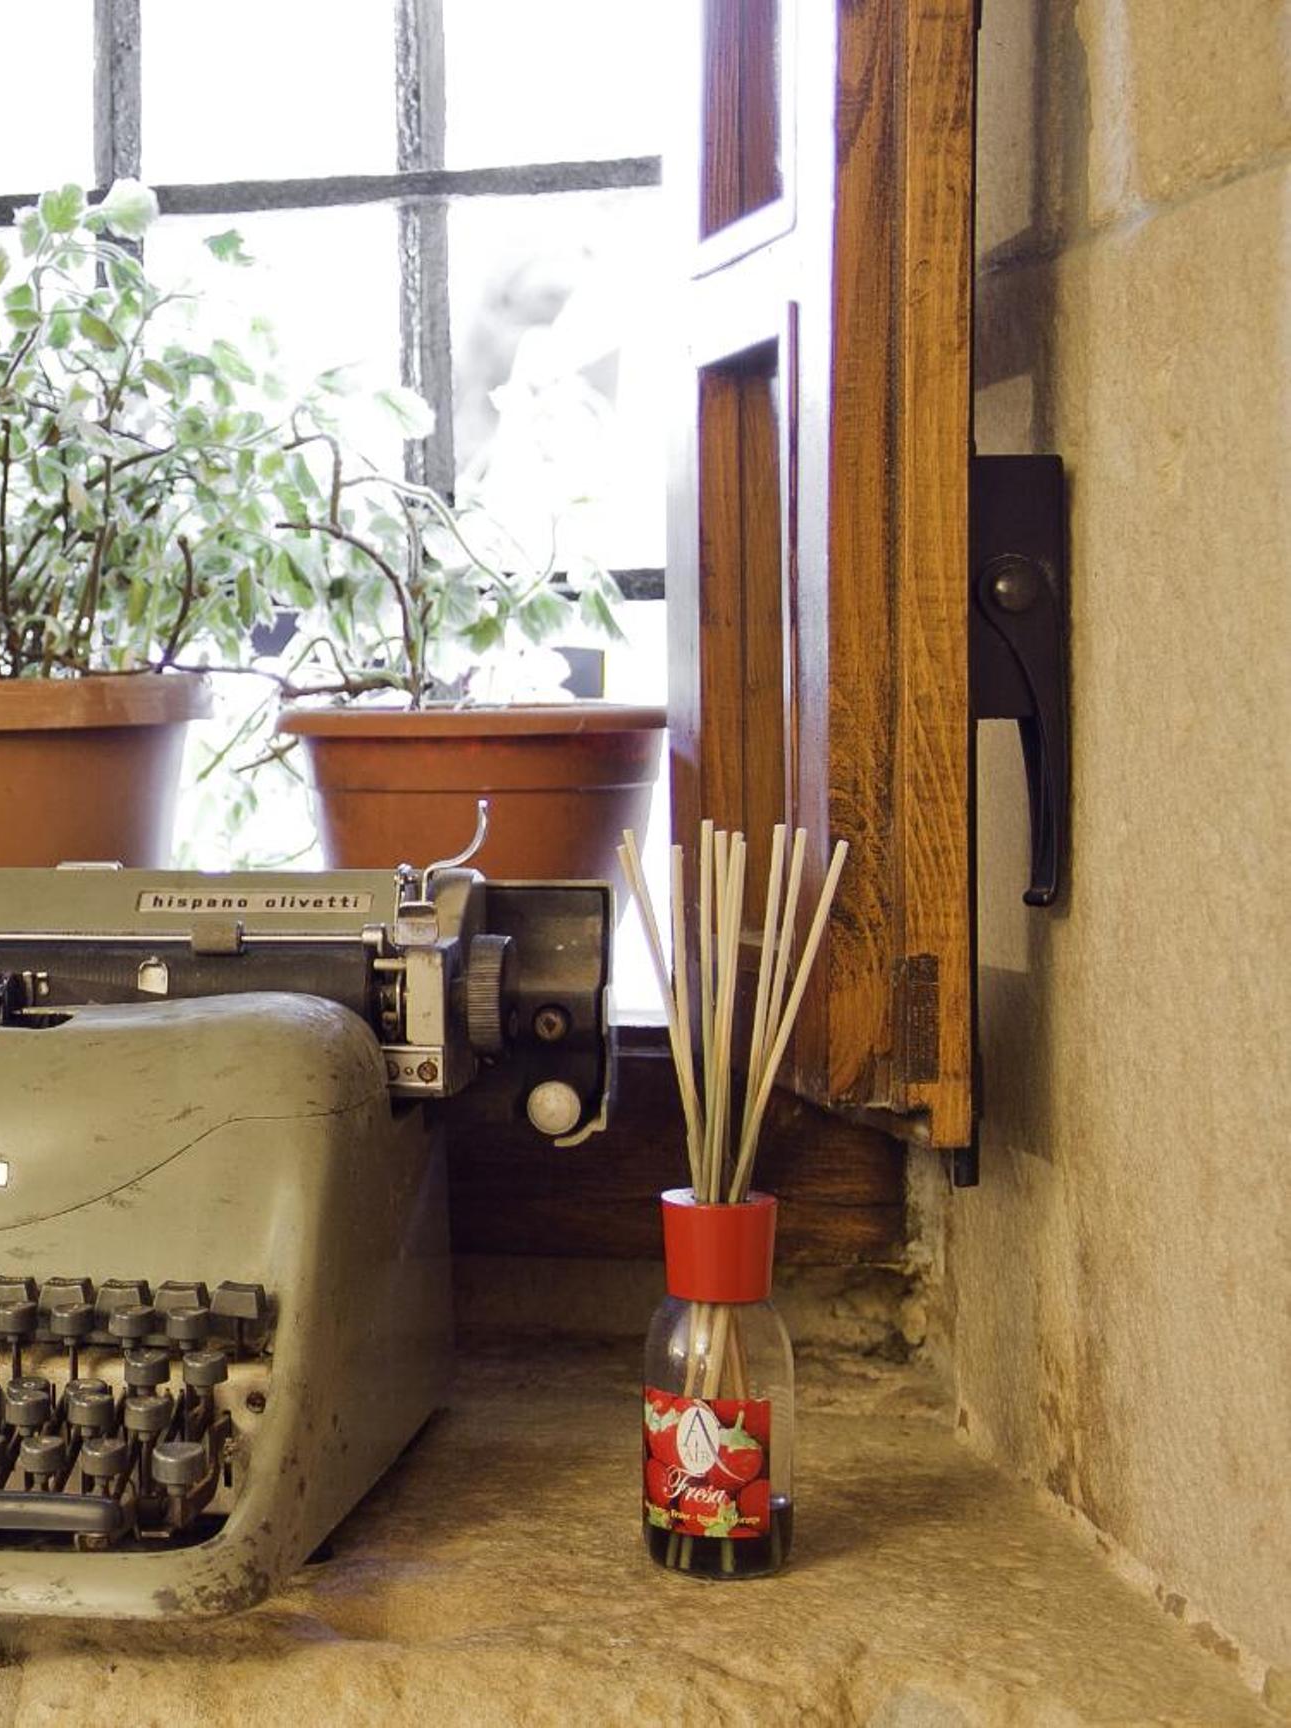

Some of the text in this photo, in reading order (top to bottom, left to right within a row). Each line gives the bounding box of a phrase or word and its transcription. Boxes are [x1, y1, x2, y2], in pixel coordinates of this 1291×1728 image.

[151, 895, 360, 911] hispano olivetti
[663, 1465, 728, 1504] Fresa
